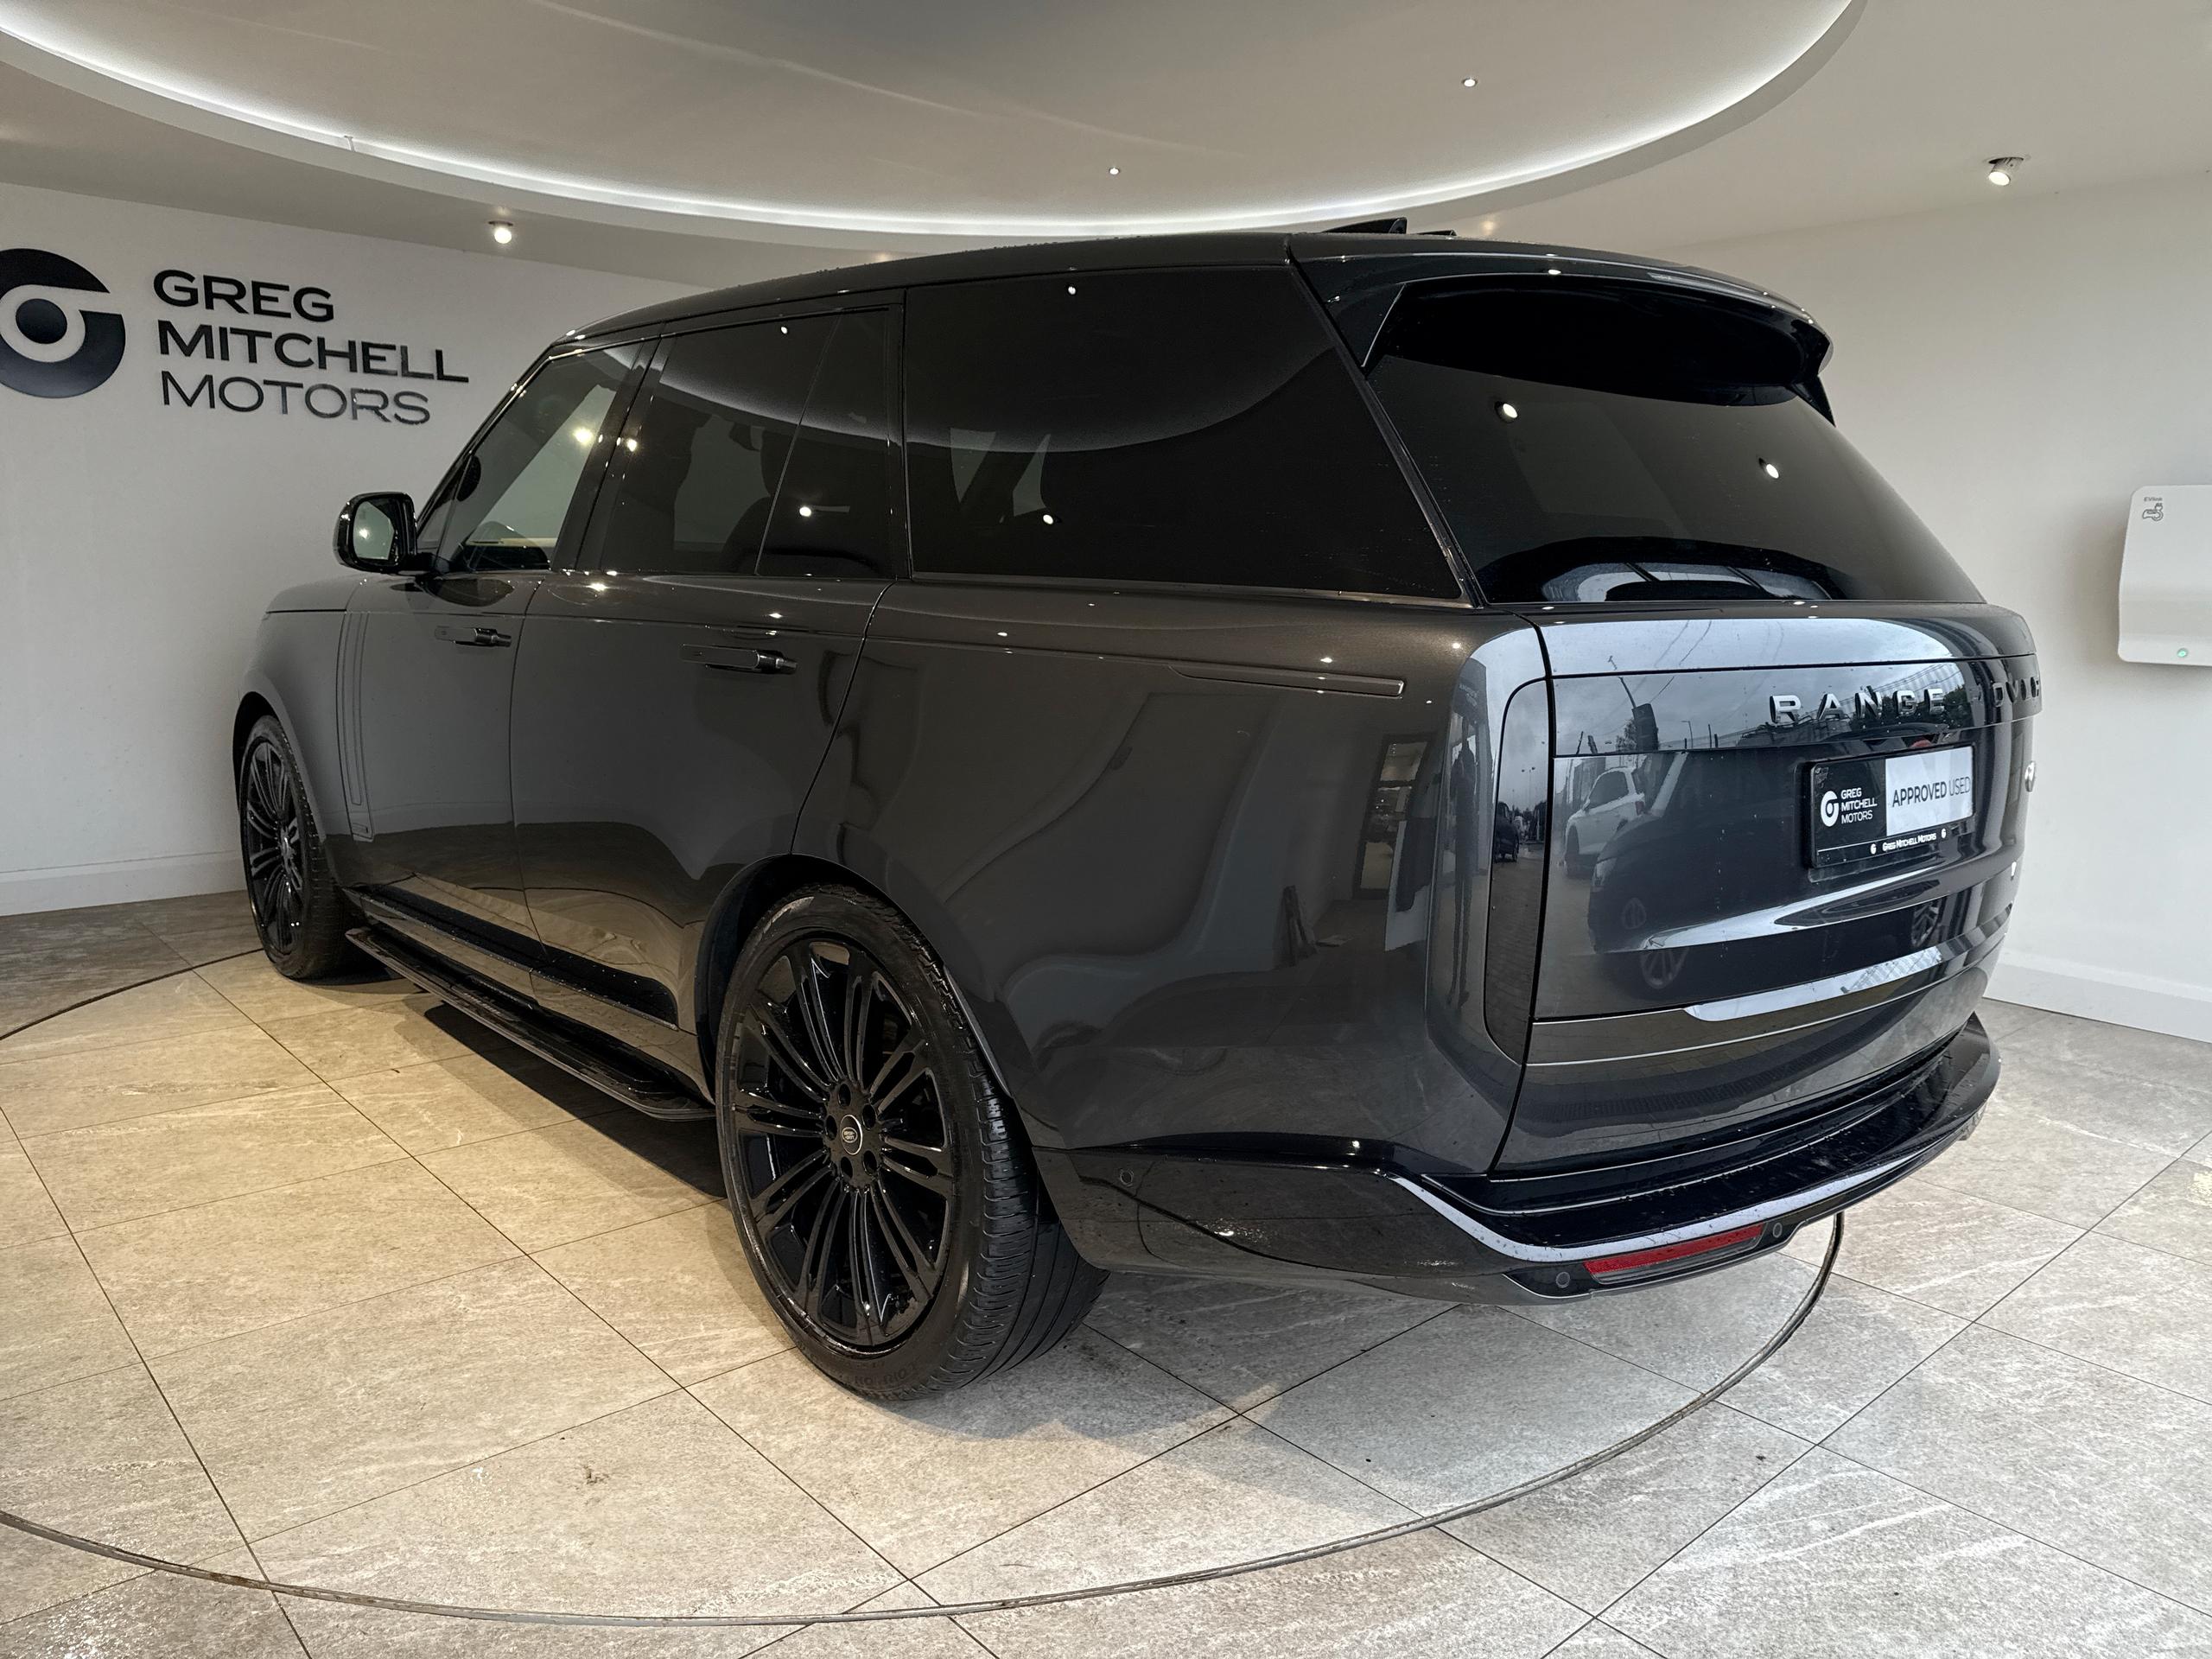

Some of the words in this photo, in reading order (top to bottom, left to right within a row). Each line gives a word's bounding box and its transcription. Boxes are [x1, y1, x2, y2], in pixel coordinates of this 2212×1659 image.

[153, 269, 334, 323] GREG
[157, 319, 469, 384] MITCHELL
[161, 370, 430, 426] MOTORS
[1770, 688, 1945, 726] RANGE
[1840, 787, 1862, 800] GREG
[1840, 798, 1878, 811] MITCHELL
[1892, 781, 1948, 807] APPROVED
[1949, 776, 1971, 797] USED
[1840, 809, 1873, 824] MOTORS
